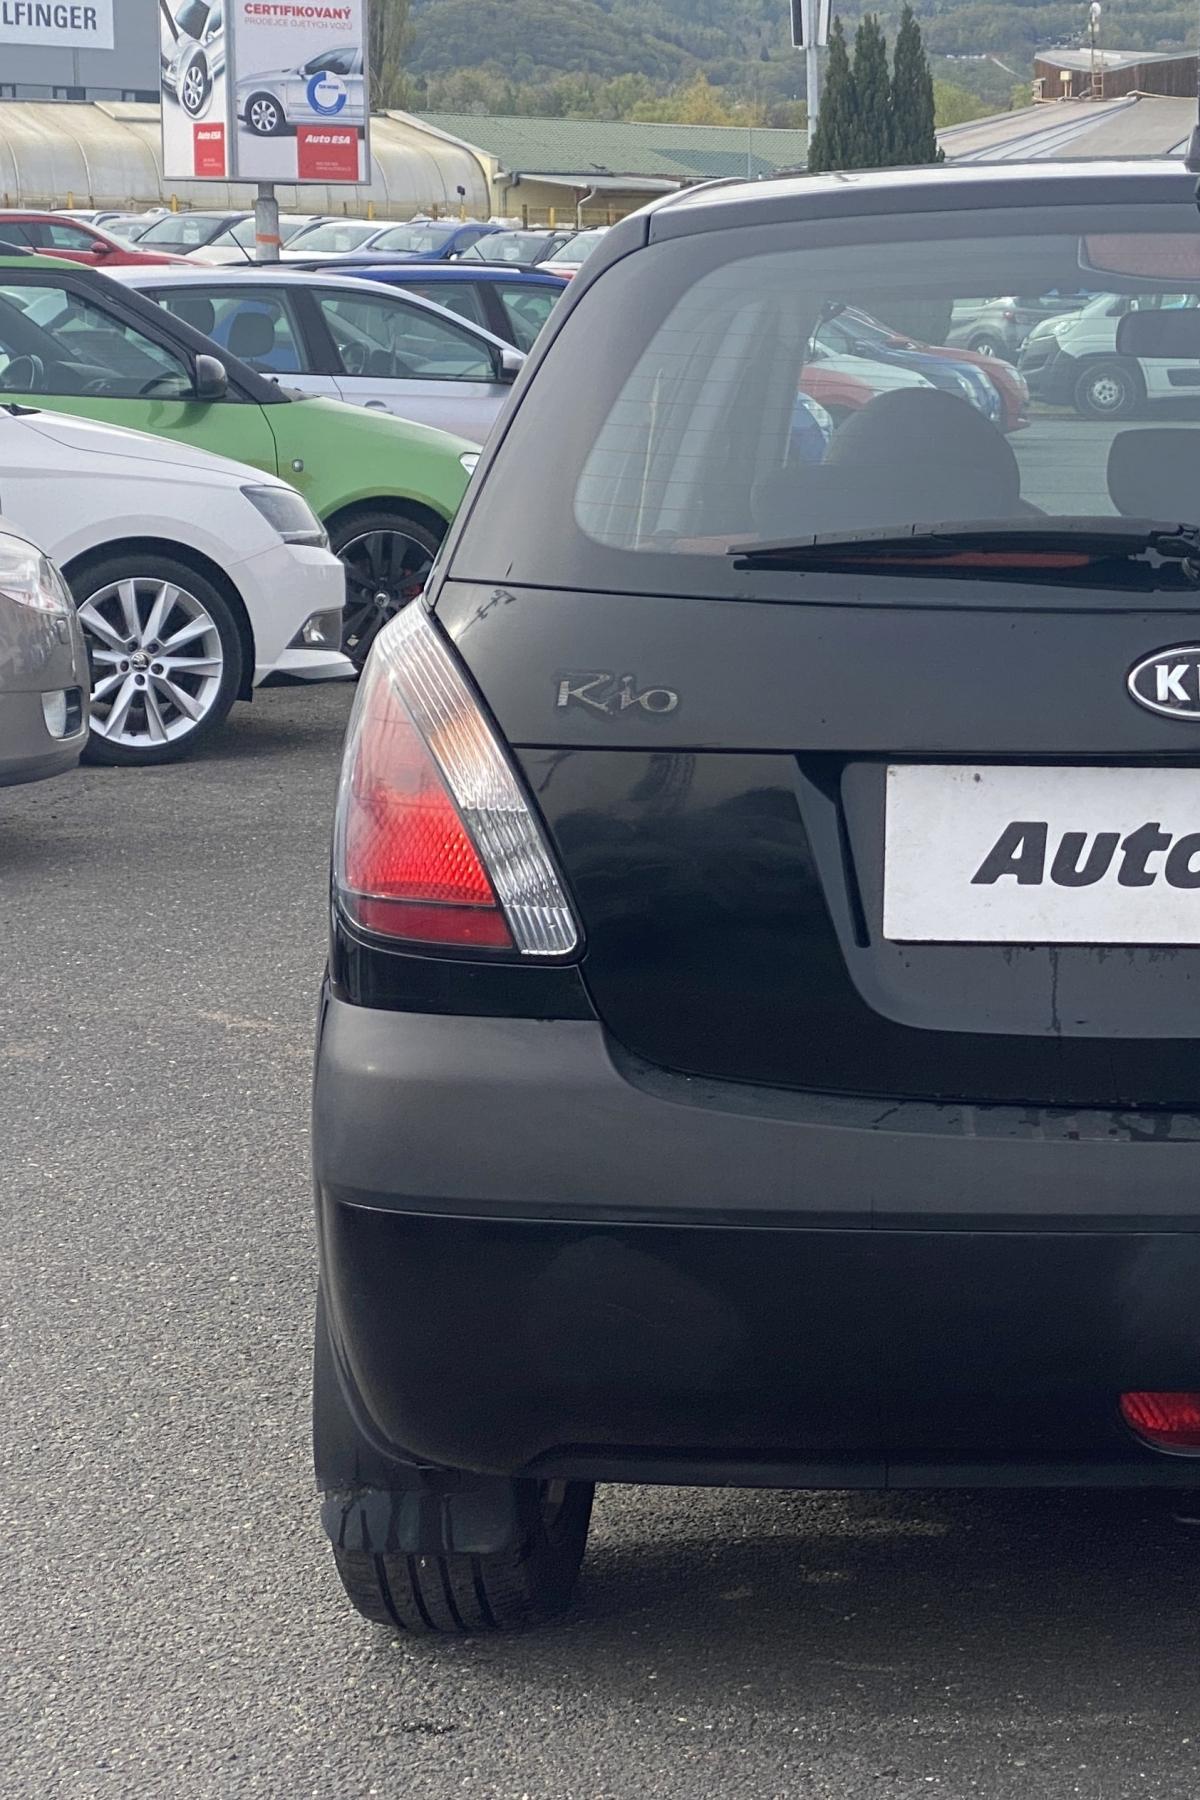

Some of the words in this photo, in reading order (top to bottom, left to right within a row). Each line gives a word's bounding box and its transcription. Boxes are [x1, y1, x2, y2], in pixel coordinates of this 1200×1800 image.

[2, 2, 97, 30] LFINGER
[244, 3, 352, 19] CERTIFIKOVANÝ
[305, 134, 331, 144] Auto
[331, 135, 351, 144] ESA
[556, 670, 678, 714] Rio
